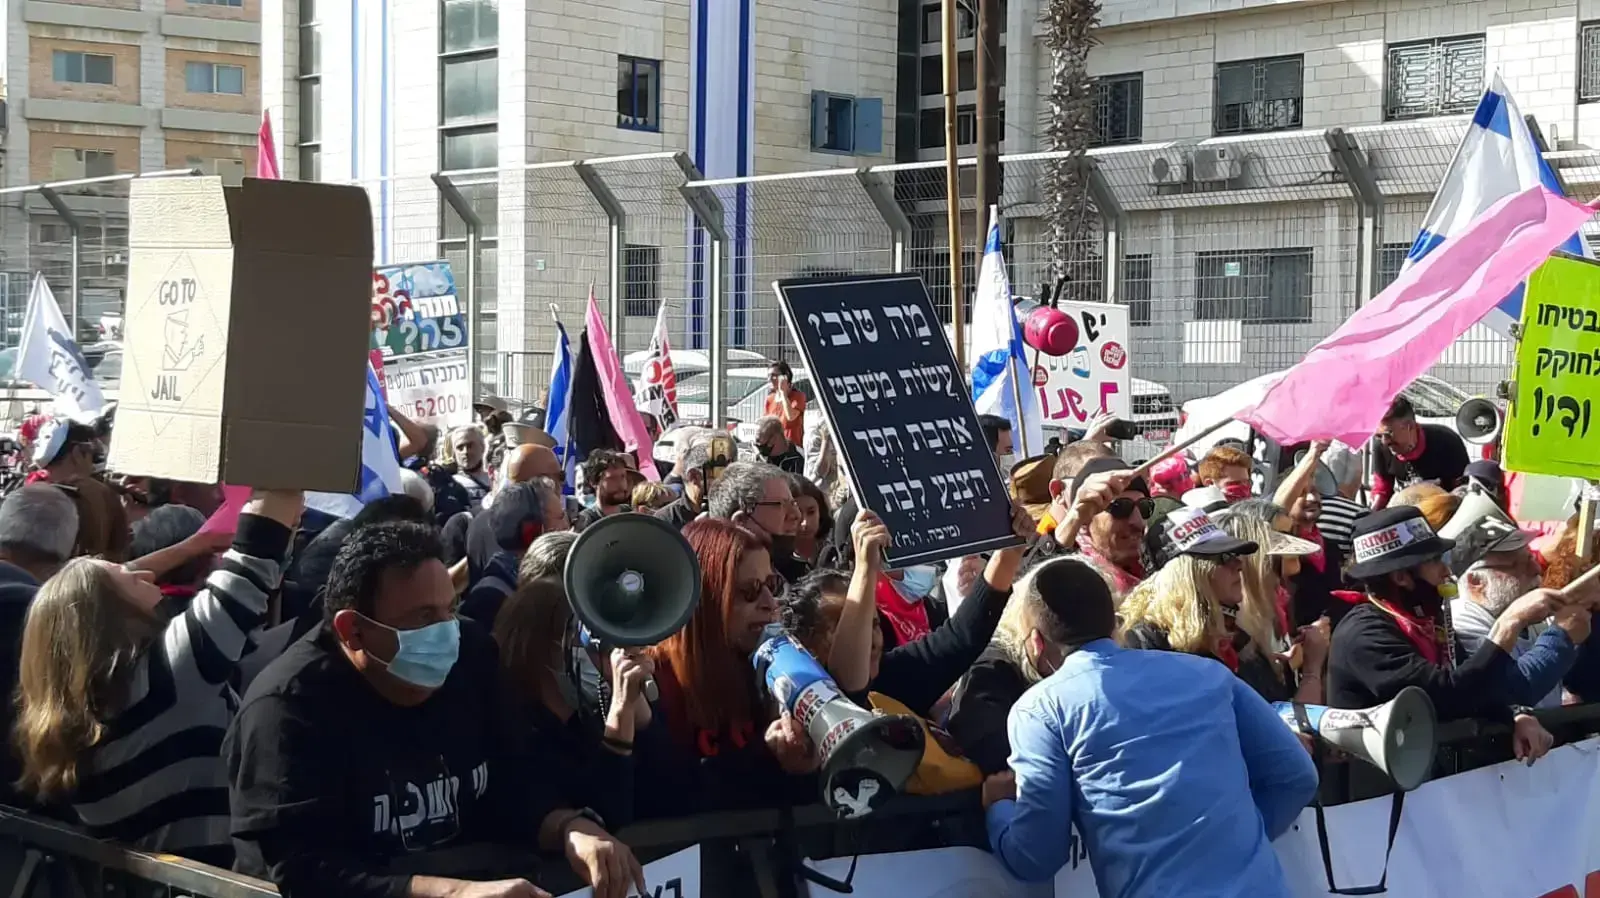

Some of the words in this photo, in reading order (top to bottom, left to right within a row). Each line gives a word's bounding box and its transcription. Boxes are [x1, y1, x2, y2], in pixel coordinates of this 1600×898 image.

[159, 280, 178, 305] GO
[181, 278, 196, 304] TO
[1537, 303, 1600, 333] בטיחו
[151, 375, 181, 401] JAIL
[415, 394, 456, 418] 6200
[1532, 386, 1591, 438] ודי!
